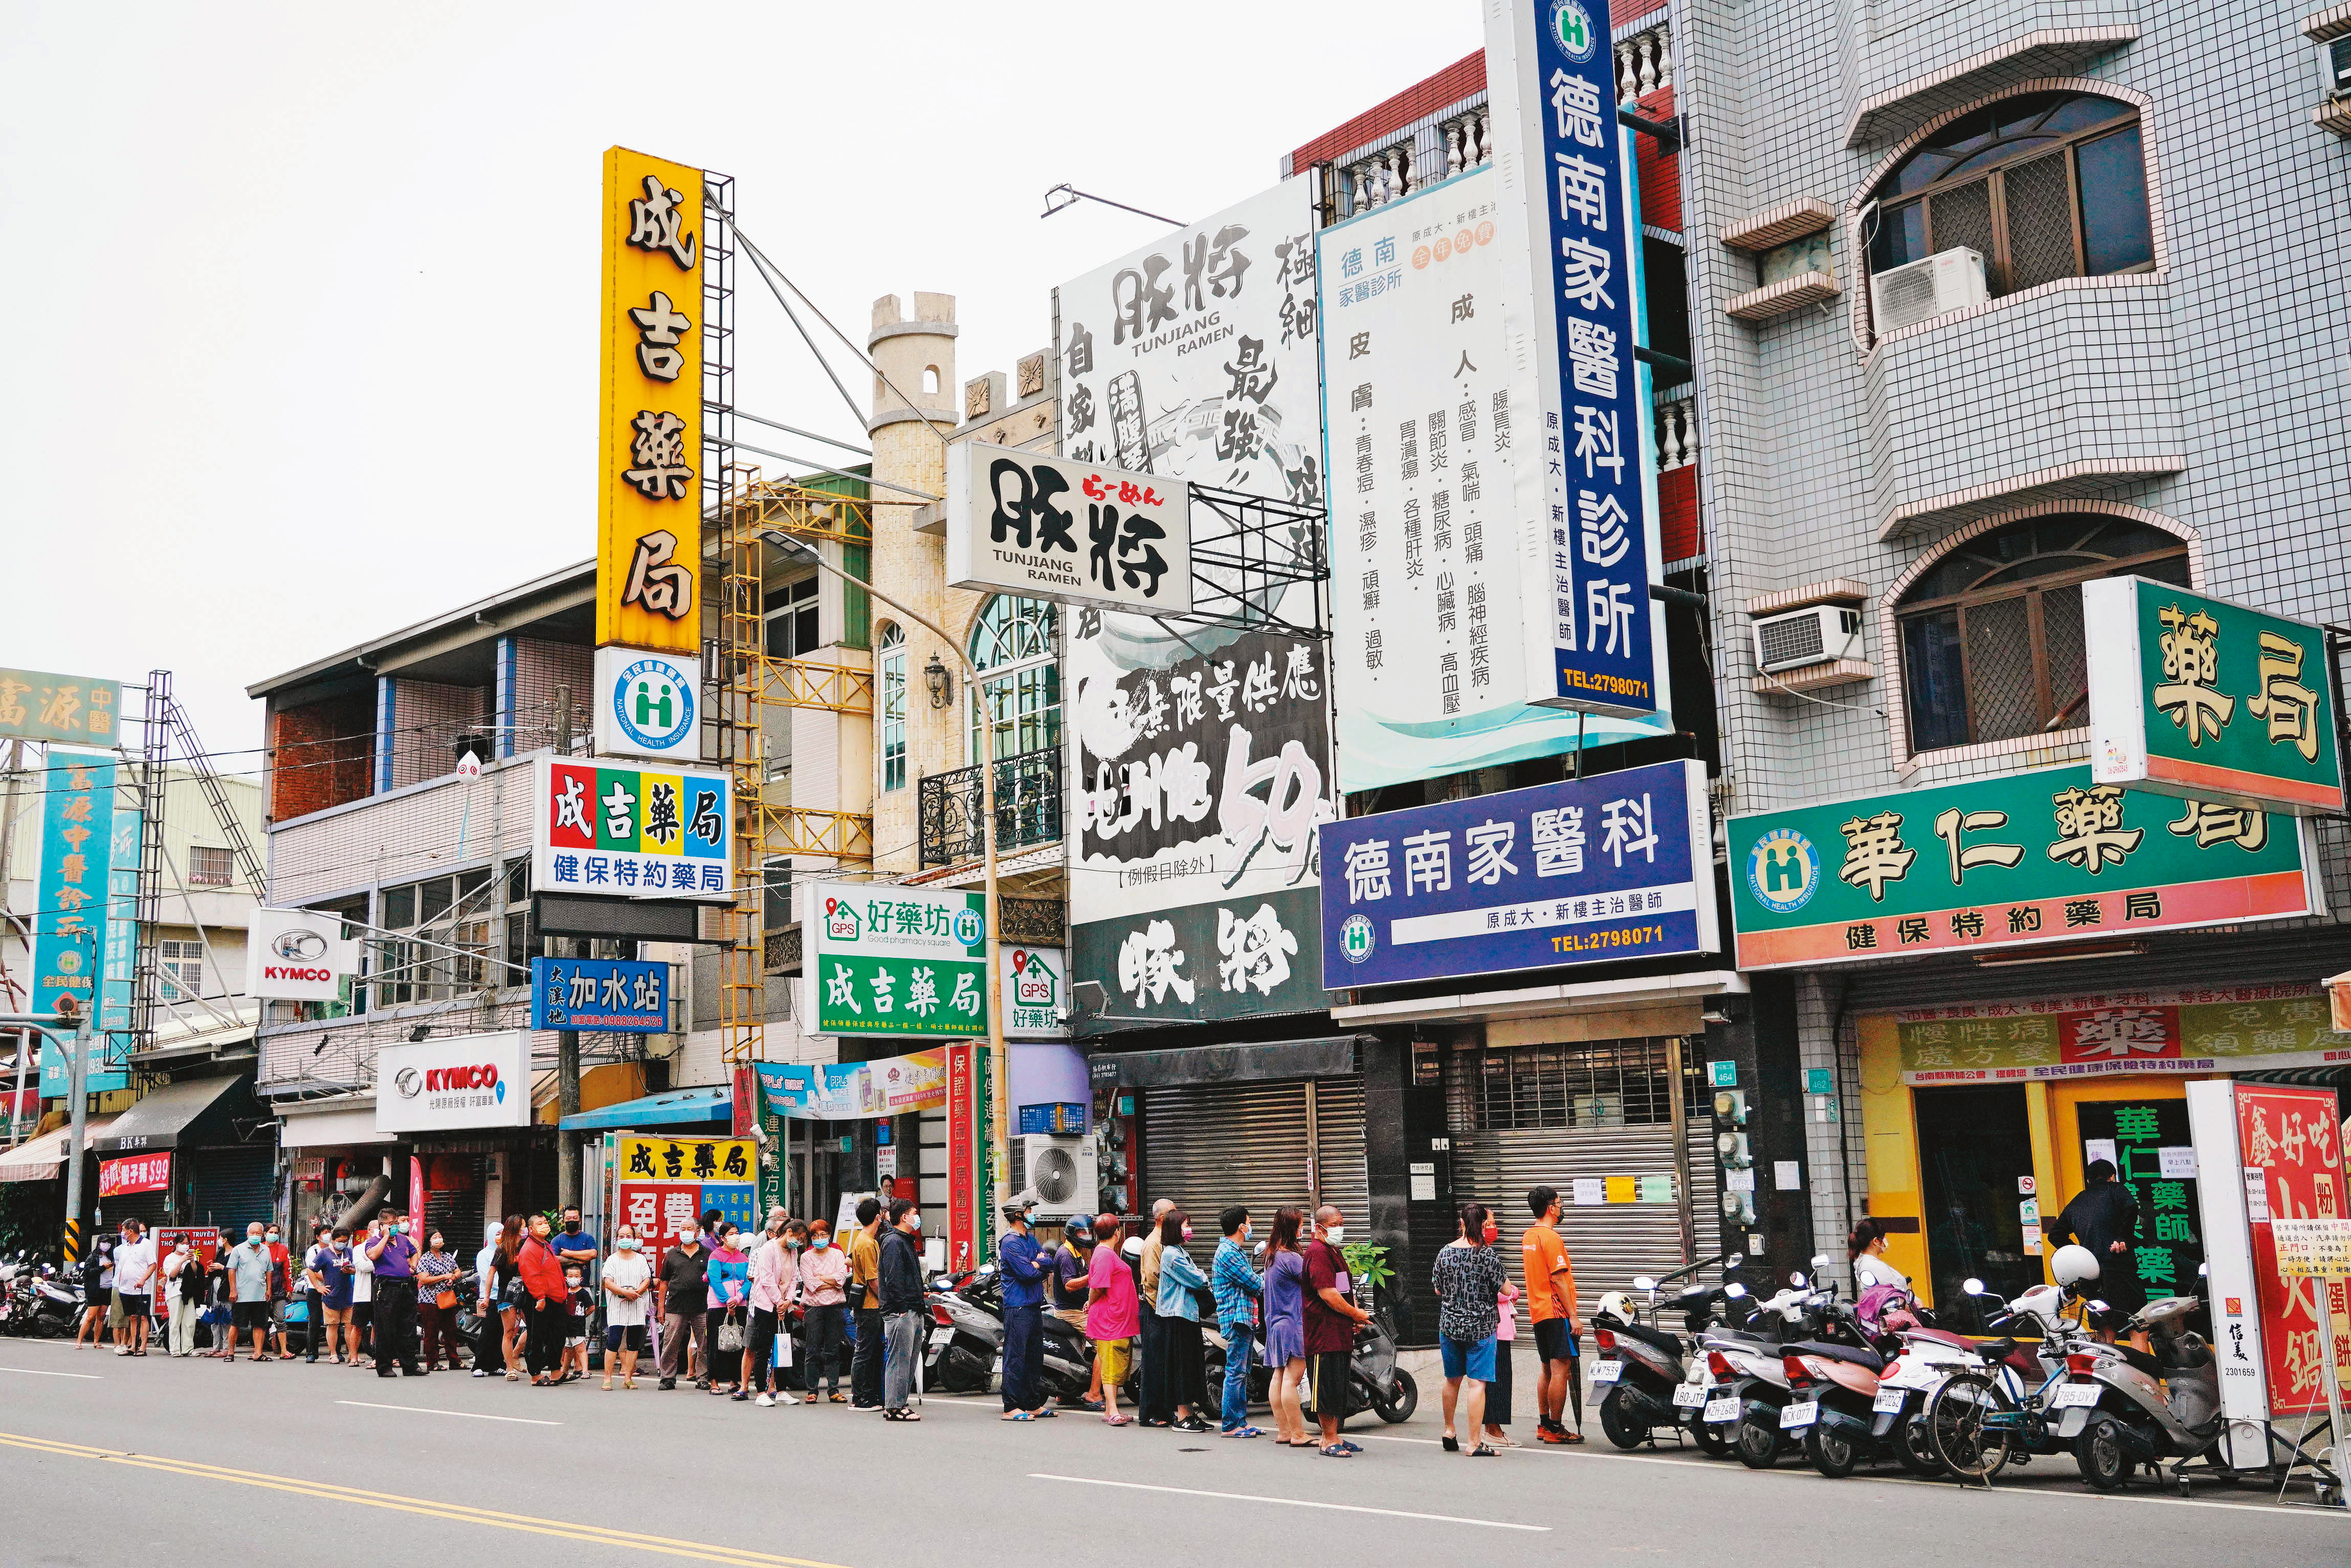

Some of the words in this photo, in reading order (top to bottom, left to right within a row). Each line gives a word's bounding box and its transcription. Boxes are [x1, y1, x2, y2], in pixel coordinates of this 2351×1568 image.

[1550, 21, 1565, 51] NATIONAL
[1565, 50, 1581, 60] HEALTH
[1581, 36, 1594, 60] INSURANCE
[1341, 236, 1396, 279] 德南
[1413, 222, 1493, 267] 全年免費
[1275, 232, 1317, 351] 極細
[1339, 268, 1402, 307] 家醫診所
[1132, 310, 1221, 357] TUNJIANG
[1177, 324, 1234, 357] RAMEN
[1550, 68, 1634, 658] 德南家醫科診所
[621, 175, 696, 620] 成吉藥局
[1215, 334, 1278, 463] 最強
[1082, 474, 1164, 507] らーめん
[993, 549, 1073, 572] TUNJIANG
[1028, 569, 1081, 586] RAMEN
[623, 660, 687, 689] 全民健康保險
[1563, 668, 1649, 699] TEL:2798071
[2153, 602, 2320, 765] 藥局
[89, 687, 111, 733] 中醫
[616, 698, 635, 736] NATIONAL
[637, 734, 665, 747] HEALTH
[668, 706, 692, 744] INSURANCE
[557, 774, 723, 846] 成吉藥局
[1344, 792, 1659, 905] 德南家醫科
[1751, 830, 1811, 858] 全民健康保險
[553, 853, 724, 891] 健保特約藥局
[1749, 874, 1769, 906] NATIONAL
[1772, 902, 1797, 910] HEALTH
[1797, 865, 1818, 905] INSURANCE
[831, 922, 855, 935] GPS
[867, 900, 950, 936] 好藥坊
[1846, 891, 2161, 950] 健保特約藥局
[868, 934, 890, 944] Good
[890, 936, 926, 947] pharmacy
[927, 938, 951, 948] square
[1551, 926, 1664, 953] TEL:2798071
[41, 975, 94, 989] 全民健保
[264, 966, 331, 981] KYMCO
[547, 965, 567, 1024] 大溪地
[568, 966, 660, 1012] 加水站
[826, 962, 981, 1018] 成吉藥局
[1021, 983, 1049, 998] GPS
[1013, 1008, 1058, 1028] 好藥坊
[426, 1063, 498, 1091] KYMCO
[1719, 1073, 1732, 1082] 464
[1812, 1080, 1826, 1089] 462
[429, 1096, 466, 1109] 光陽原廠授權
[120, 1137, 134, 1149] BK
[149, 1158, 168, 1184] $99
[629, 1143, 748, 1178] 成吉藥局
[705, 1193, 751, 1205] 成大奇美
[1589, 1366, 1620, 1377] MLM-7539
[2225, 1368, 2256, 1377] 2301659
[1675, 1391, 1705, 1405] 180-JTP
[1705, 1402, 1739, 1417] MZH-2680
[2058, 1390, 2099, 1403] 785-DVX
